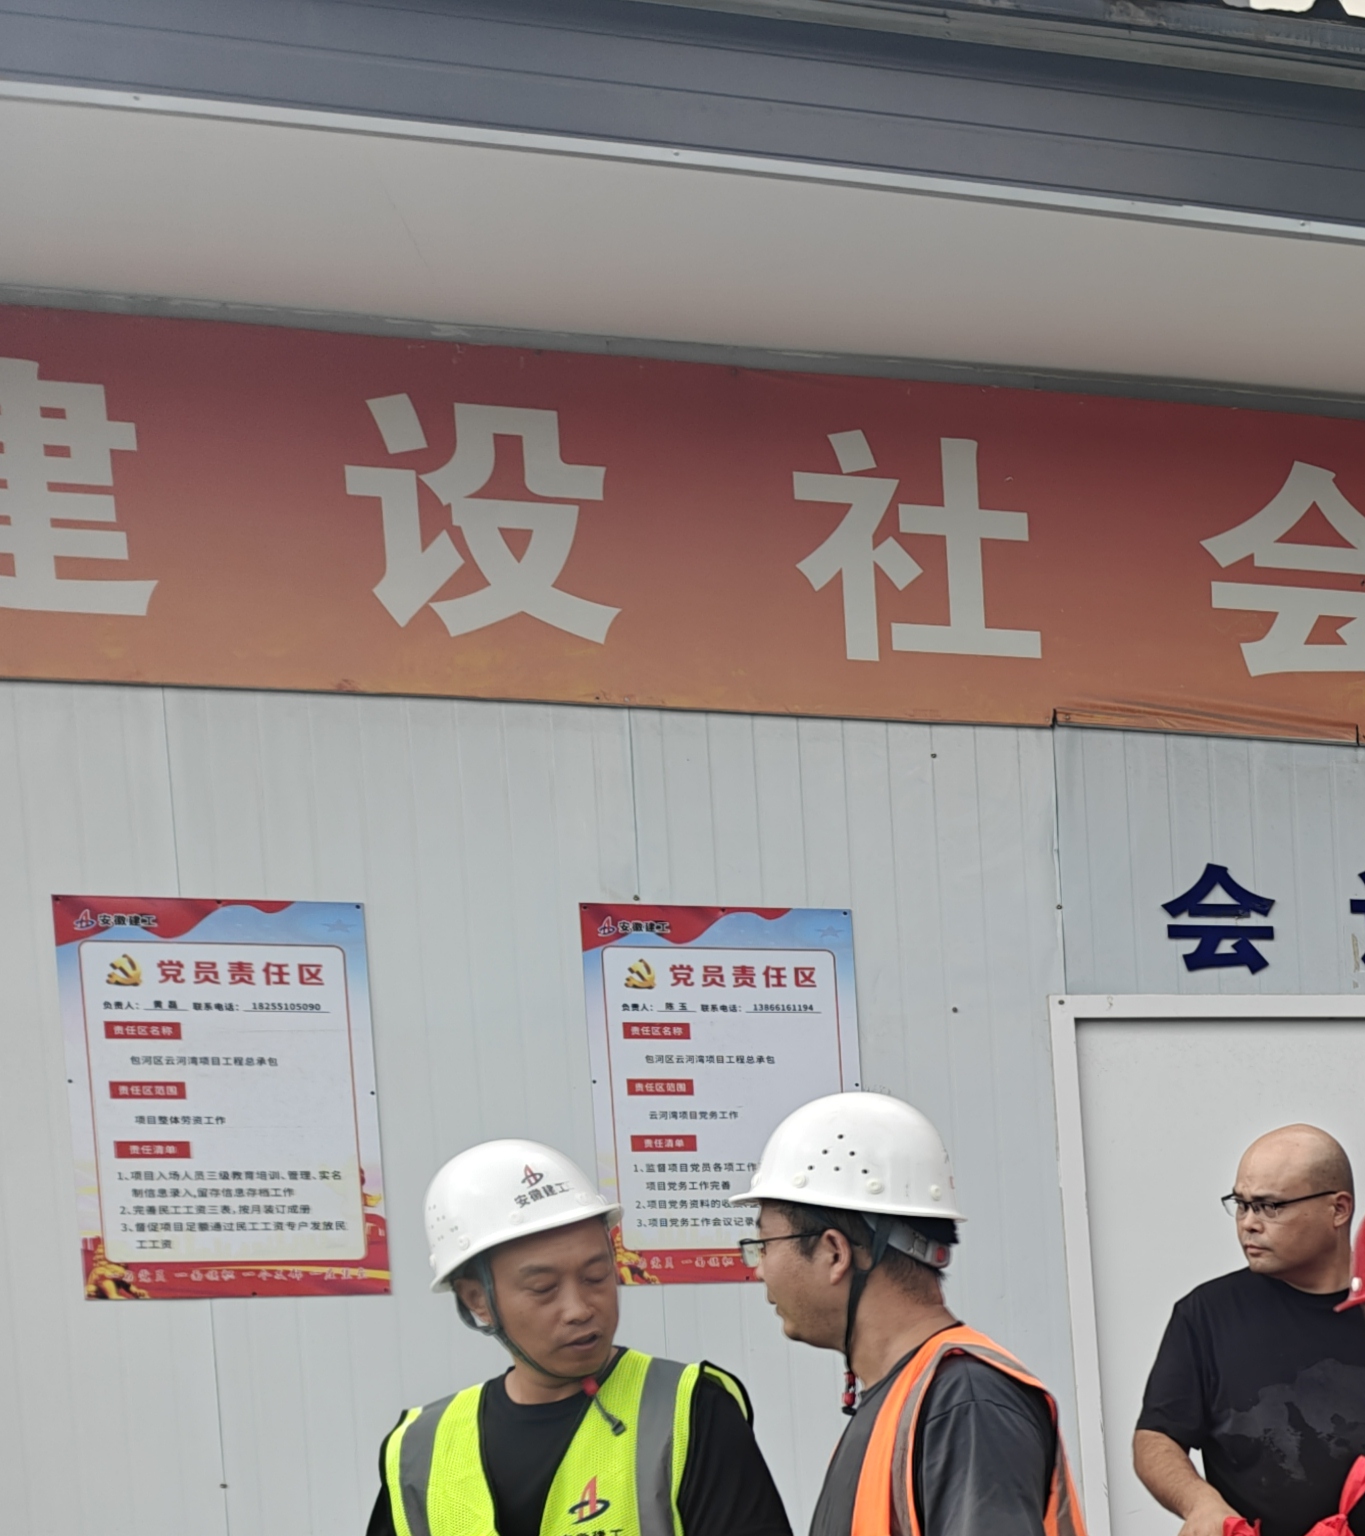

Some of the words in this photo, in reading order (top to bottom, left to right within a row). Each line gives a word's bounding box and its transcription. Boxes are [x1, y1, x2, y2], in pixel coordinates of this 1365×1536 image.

[98, 914, 157, 927] 安徽建工
[618, 920, 670, 933] 安徽建工
[157, 959, 325, 987] 党员责任区
[669, 964, 817, 988] 党员责任区
[103, 1001, 139, 1012] 负责人：
[193, 1001, 240, 1012] 联系电话：
[621, 1003, 654, 1012] 负责人：
[701, 1003, 742, 1013] 联系电话：
[753, 1003, 814, 1012] 13866161194
[113, 1025, 173, 1037] 责任区名称
[630, 1026, 683, 1036] 责任区名称
[130, 1055, 278, 1067] 包河区云河湾项目工程总承包
[645, 1054, 775, 1064] 包河区云河湾项目工程总承包
[118, 1084, 178, 1096] 责任区范围
[635, 1082, 687, 1093] 责任区范围
[134, 1115, 226, 1126] 项目整体劳资工作
[649, 1110, 739, 1120] 云河湾项目党务工作
[643, 1138, 685, 1148] 责任清单
[129, 1144, 178, 1155] 责任清单
[633, 1163, 759, 1173] 1、监督项目党员各项工作
[646, 1181, 731, 1191] 项目党务工作完善
[135, 1239, 172, 1250] 工工资
